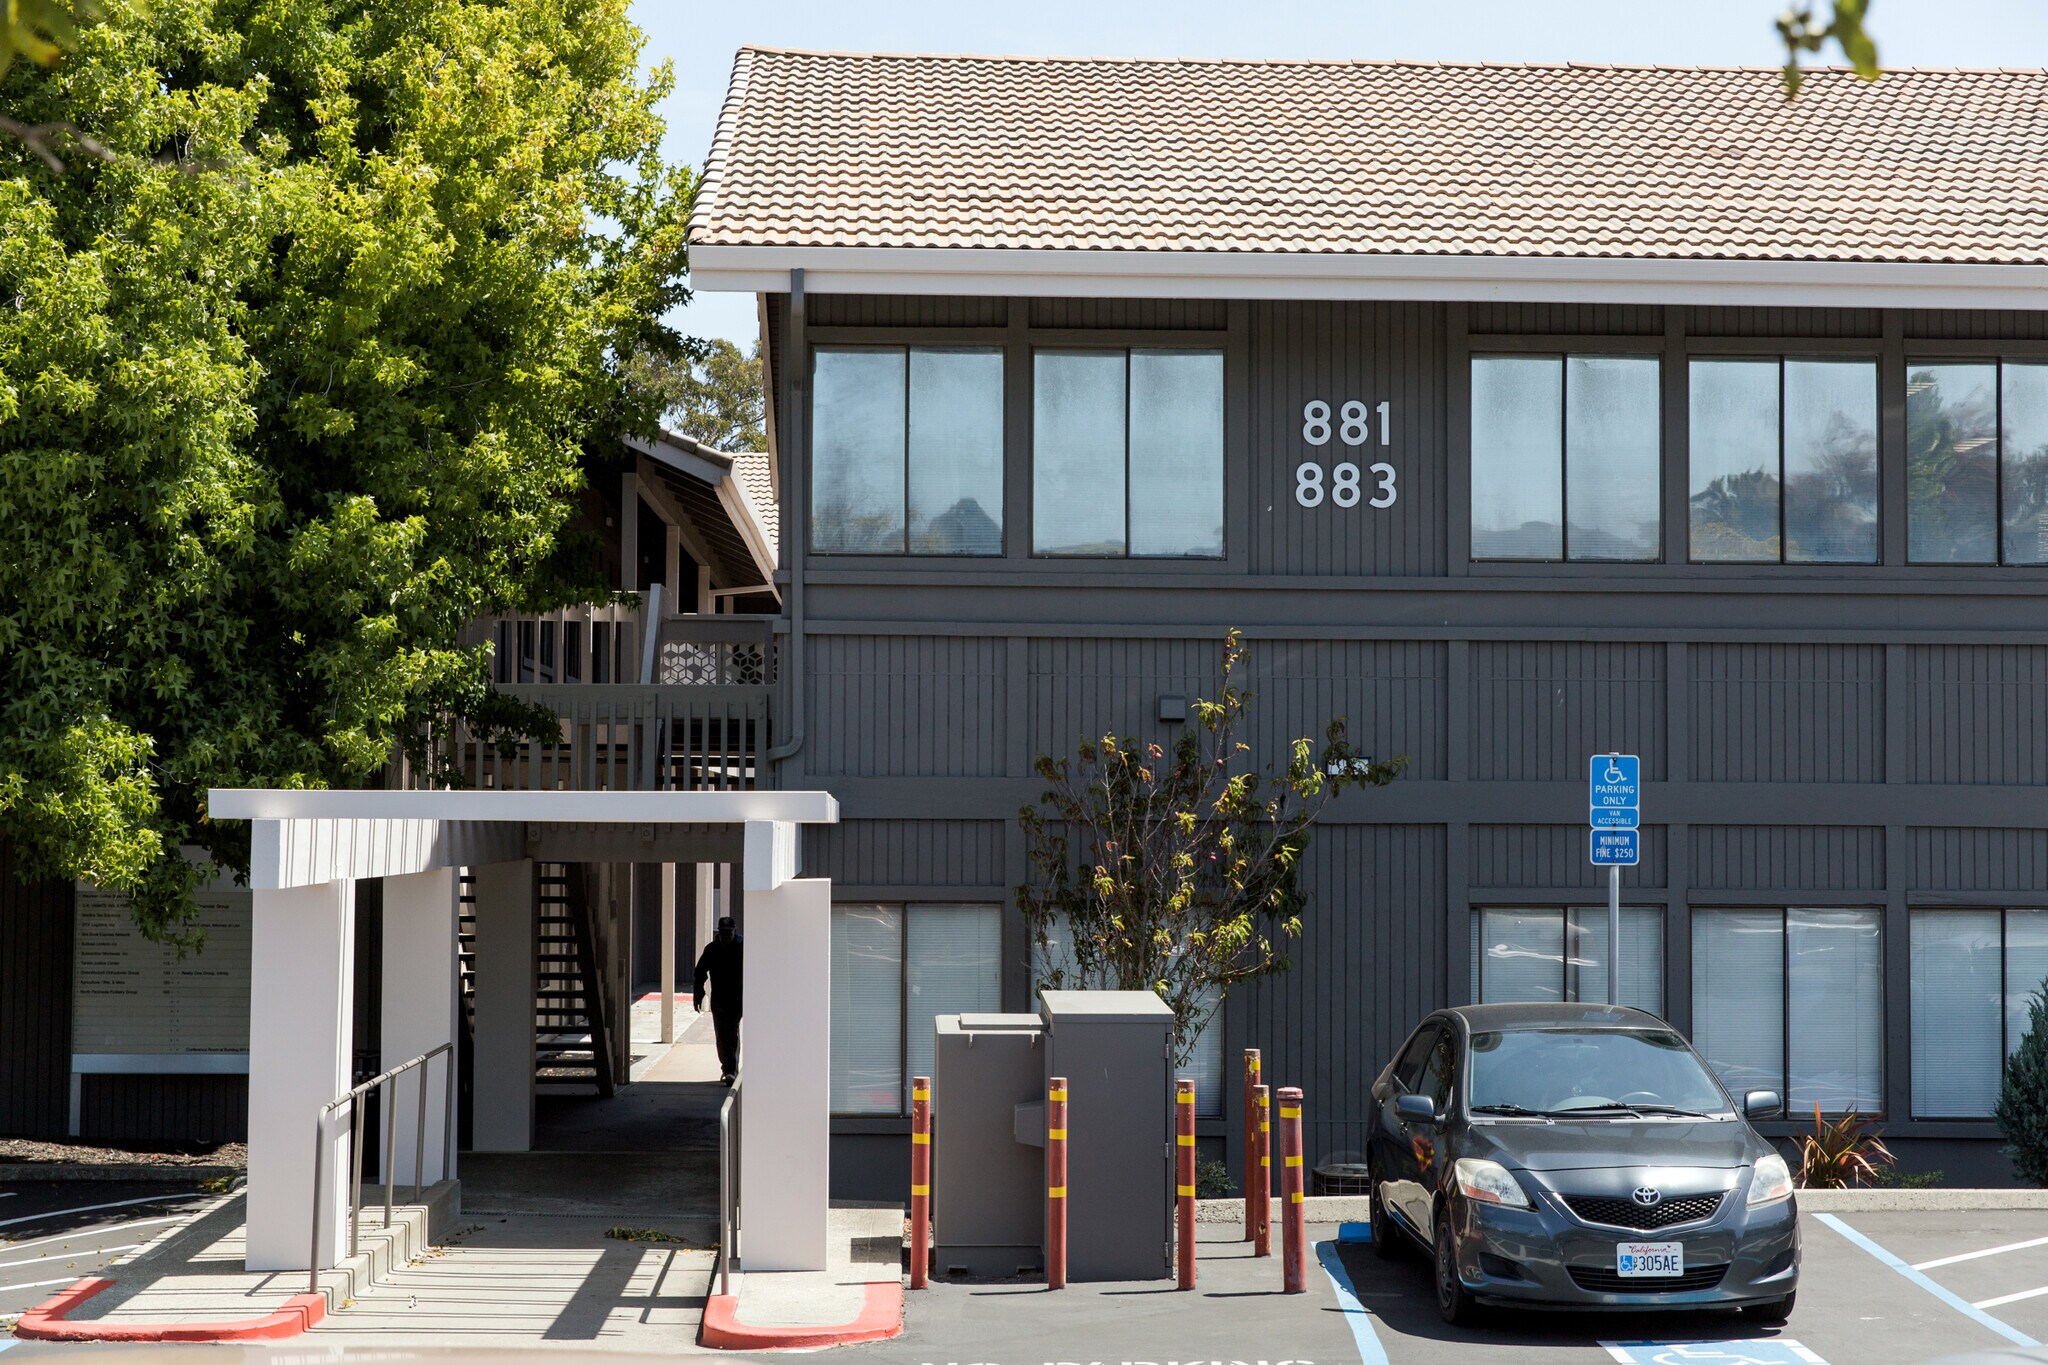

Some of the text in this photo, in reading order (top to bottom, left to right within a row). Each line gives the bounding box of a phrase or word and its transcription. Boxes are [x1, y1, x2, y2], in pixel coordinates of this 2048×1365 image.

[1302, 399, 1390, 446] 881
[1295, 461, 1398, 509] 883
[1595, 785, 1635, 794] PARKING
[1603, 796, 1627, 805] ONLY
[1597, 817, 1632, 825] ACCESSIBLE
[1599, 836, 1630, 846] MINIMUM
[1595, 847, 1634, 859] FINE $250
[1631, 1245, 1667, 1255] California
[1638, 1255, 1679, 1271] 305AE
